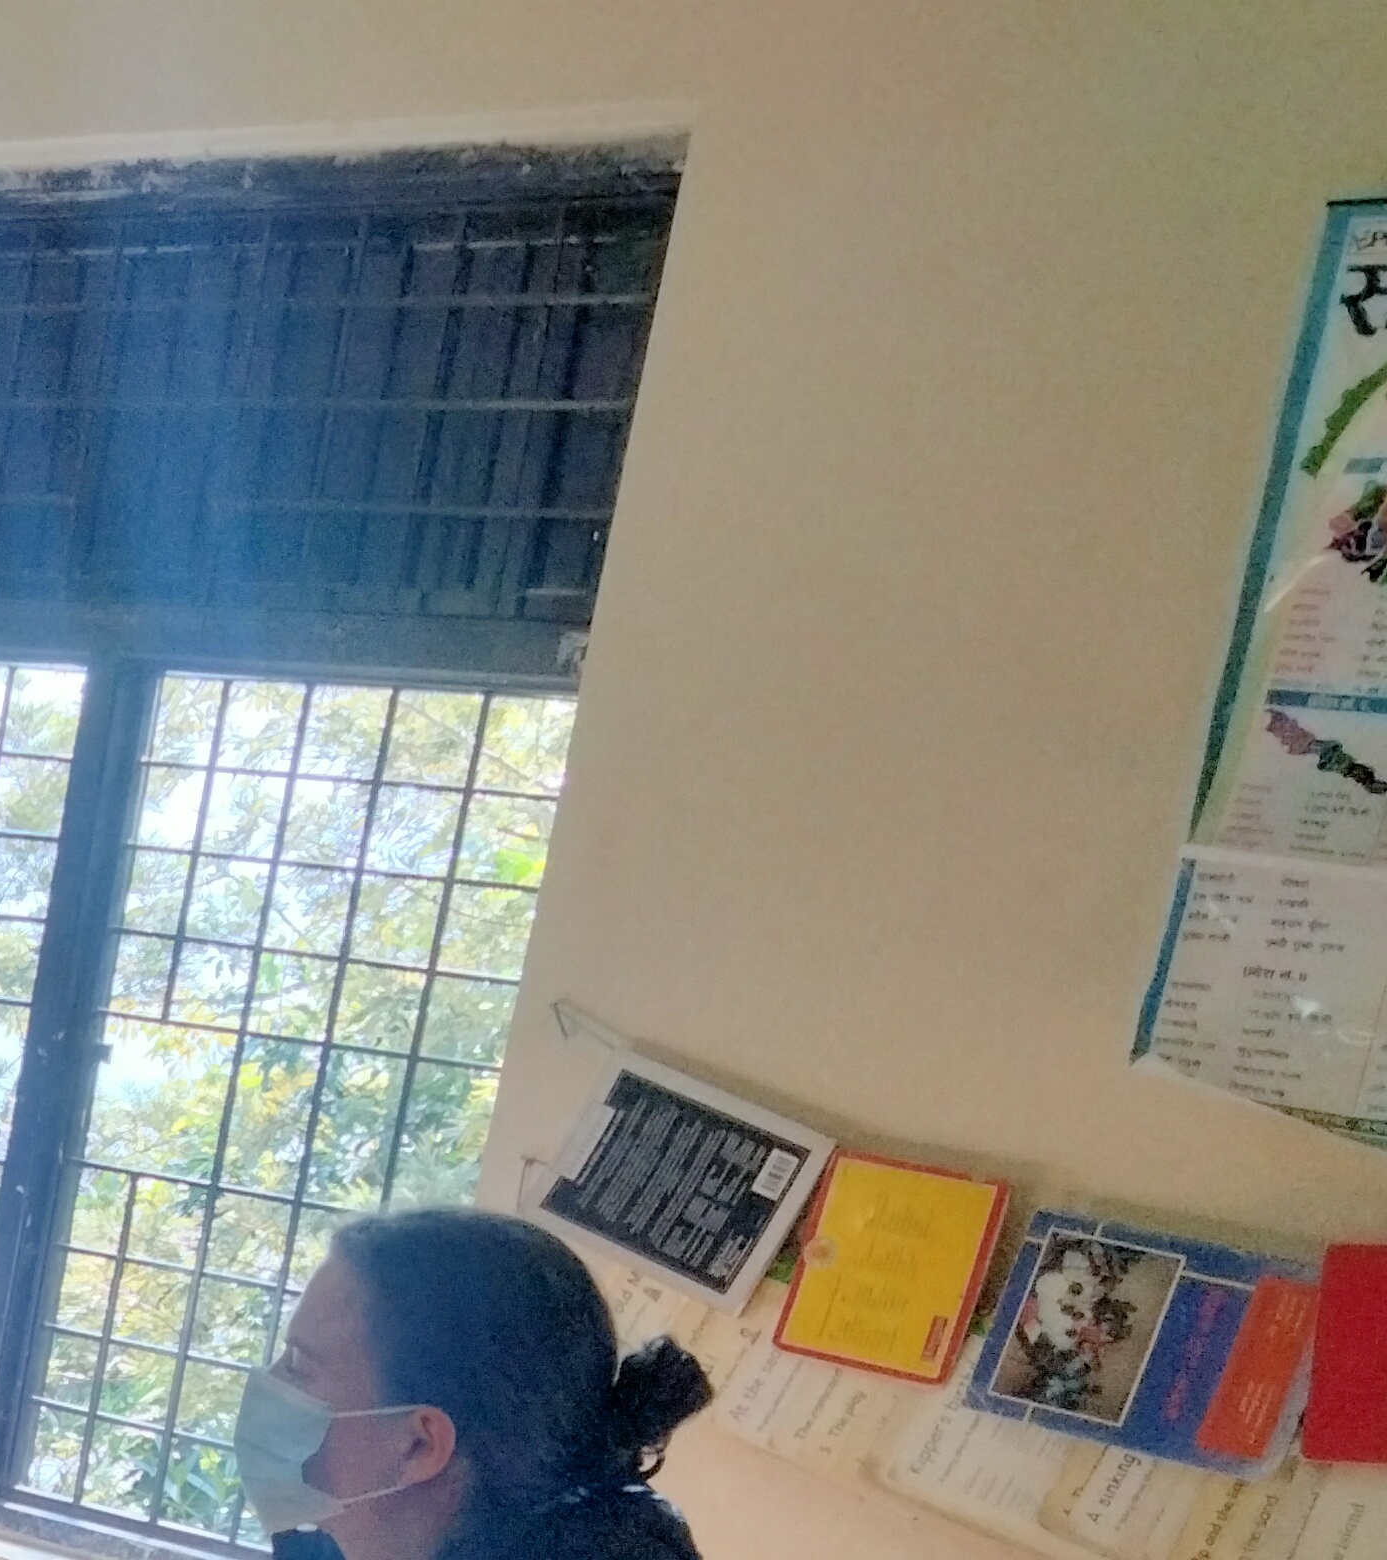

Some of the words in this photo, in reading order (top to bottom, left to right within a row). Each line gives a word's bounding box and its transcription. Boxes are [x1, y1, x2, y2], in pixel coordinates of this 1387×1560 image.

[728, 1404, 750, 1422] At
[743, 1378, 765, 1400] the
[1098, 1453, 1142, 1507] sinking
